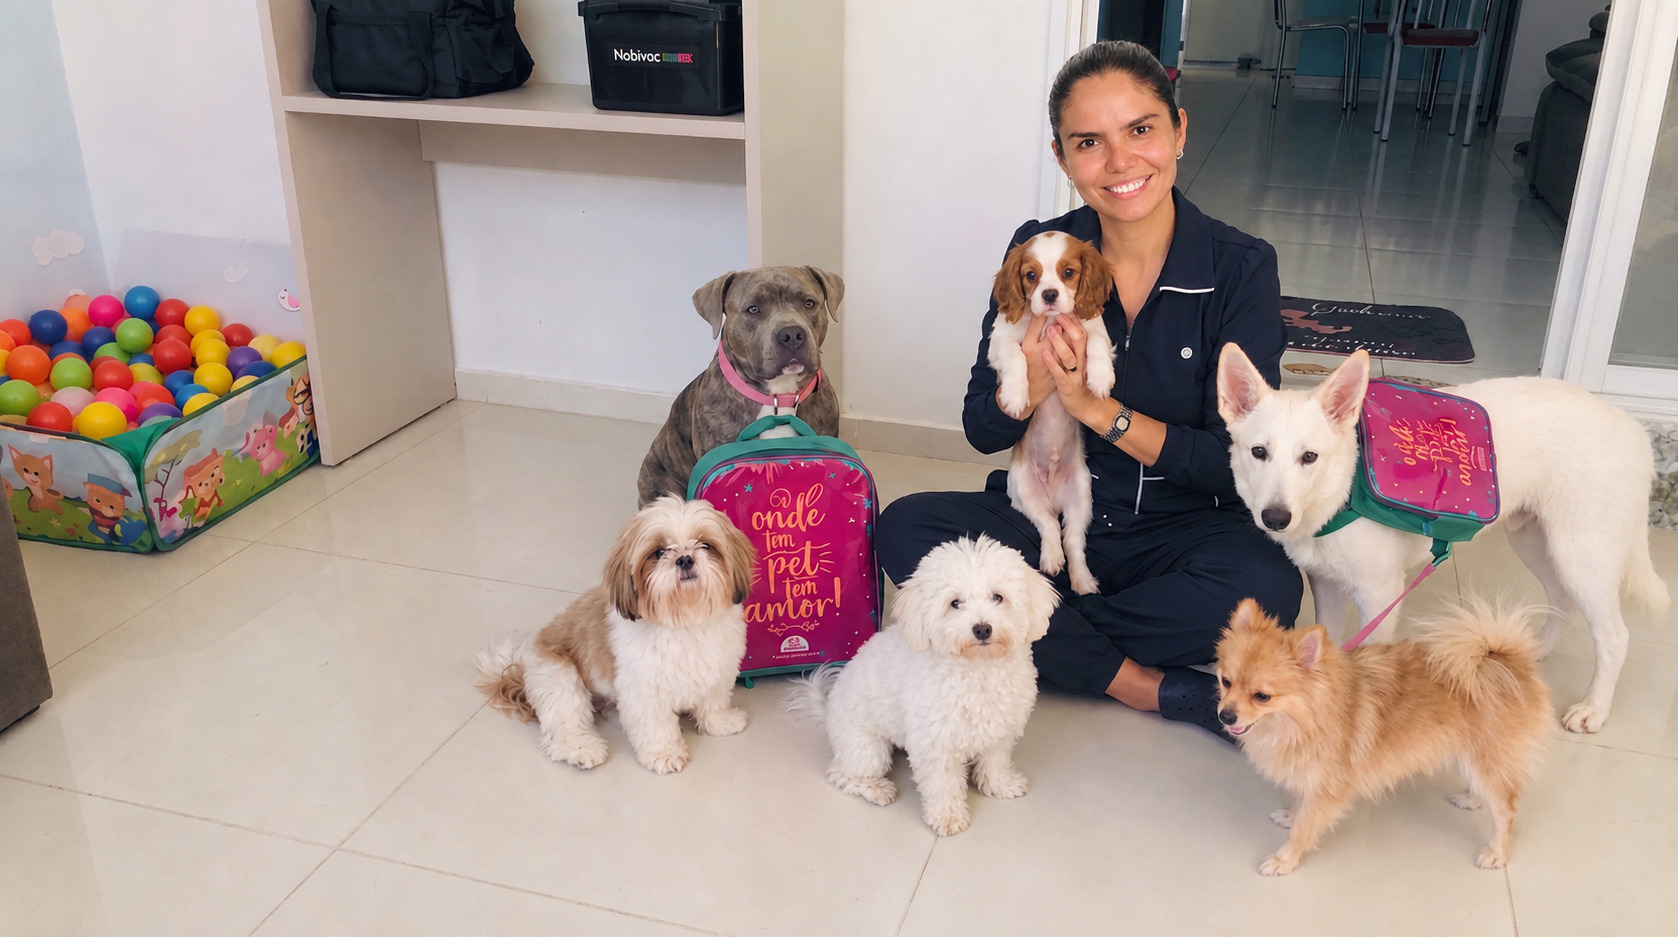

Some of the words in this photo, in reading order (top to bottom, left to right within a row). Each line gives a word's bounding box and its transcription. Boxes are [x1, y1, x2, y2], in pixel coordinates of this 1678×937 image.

[613, 48, 661, 62] Nobivac
[752, 483, 825, 532] onde
[762, 530, 796, 552] tem
[766, 541, 826, 594] pet
[745, 577, 841, 623] amor!
[782, 577, 818, 600] tem
